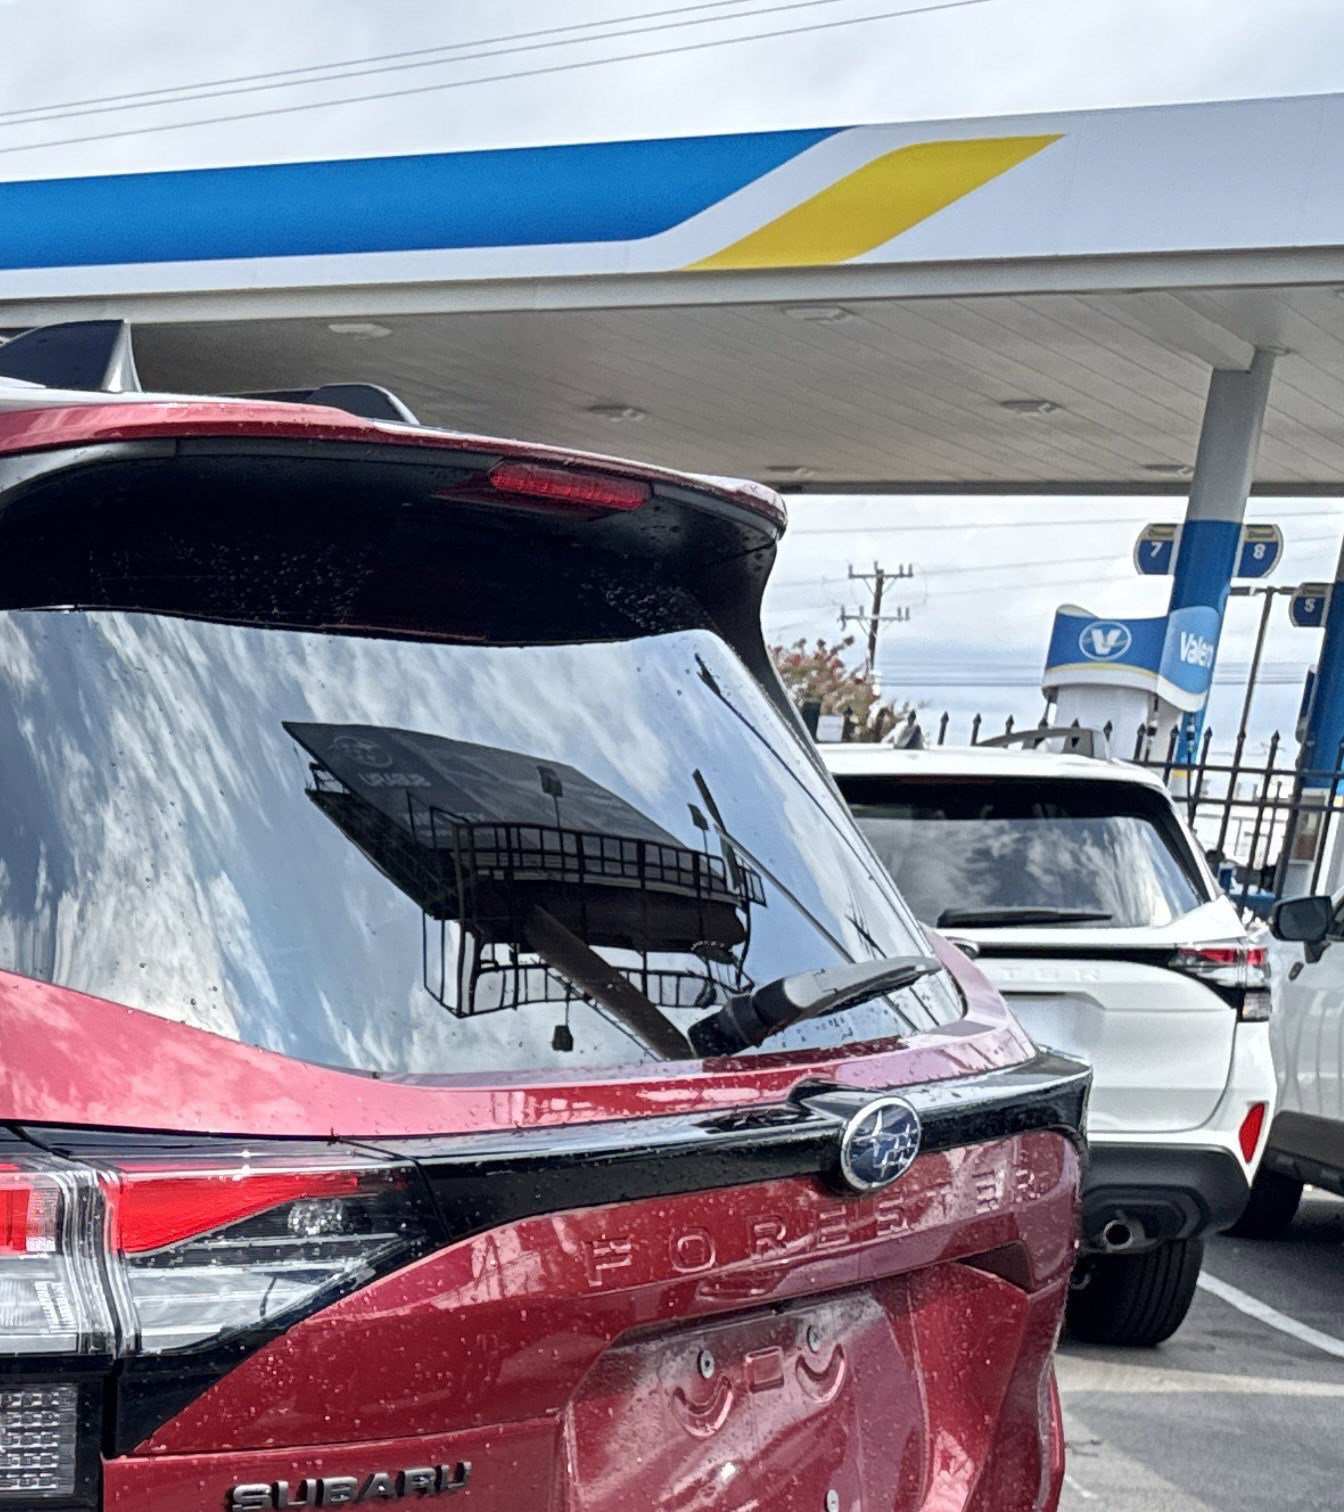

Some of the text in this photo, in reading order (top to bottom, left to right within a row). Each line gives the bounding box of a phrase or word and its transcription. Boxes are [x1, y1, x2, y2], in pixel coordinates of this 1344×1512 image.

[1150, 541, 1162, 558] 7
[1253, 543, 1266, 560] 8
[587, 1148, 1036, 1288] FORESTER
